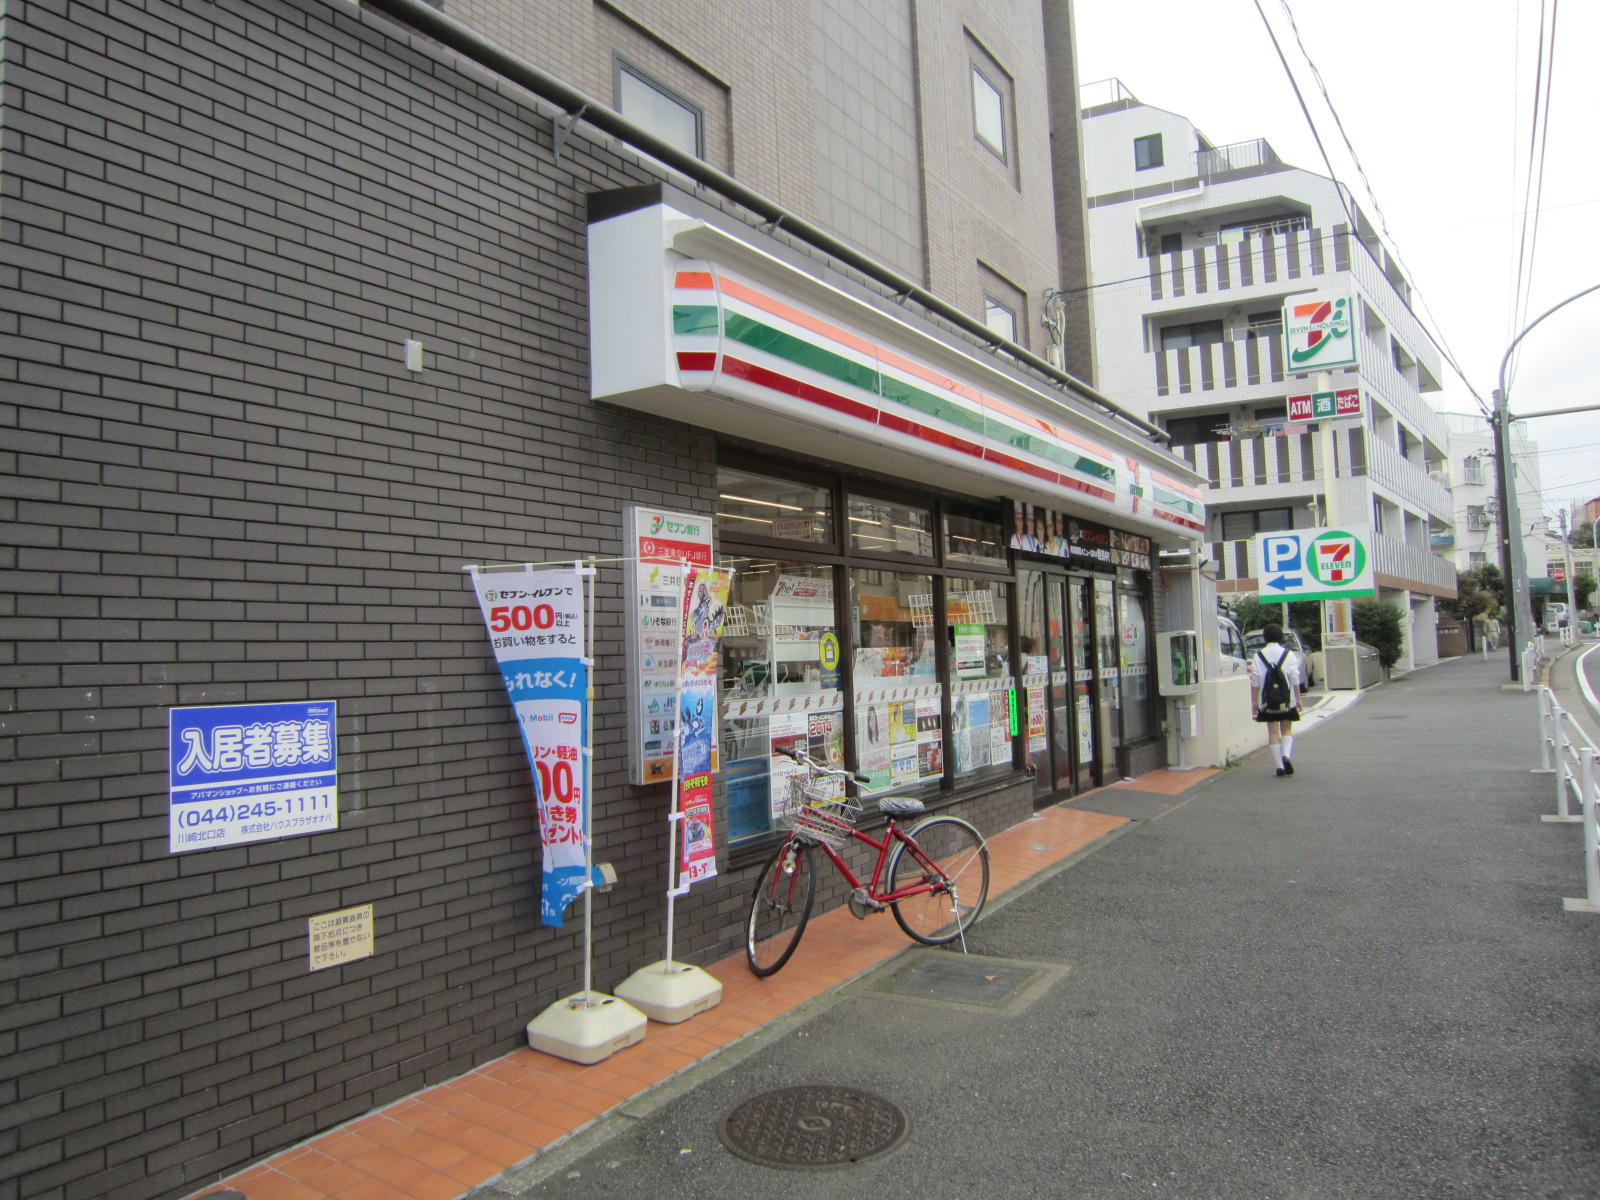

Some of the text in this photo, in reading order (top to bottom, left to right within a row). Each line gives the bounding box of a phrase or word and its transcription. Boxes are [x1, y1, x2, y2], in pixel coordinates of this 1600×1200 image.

[1290, 325, 1308, 334] SEVEN
[1316, 319, 1349, 330] HOLDINGS
[1290, 400, 1311, 416] ATM
[1316, 394, 1360, 413] 酒 たばこ
[666, 521, 700, 536] セブン銀行
[658, 547, 707, 561] 三菱東京UFJ銀行
[1267, 537, 1298, 571] P
[490, 603, 555, 633] 500
[650, 615, 677, 626] りそな銀行
[493, 633, 577, 649] お買い物をすると
[653, 680, 676, 688] ゆうちょ銀
[529, 713, 554, 722] Mobil
[808, 719, 832, 737] 2014
[178, 720, 331, 775] 入居者募集
[190, 779, 322, 800] アパマンショップへお気軽にご連絡ください
[178, 794, 329, 829] (044)245-1111
[177, 828, 226, 844] 川崎北口店
